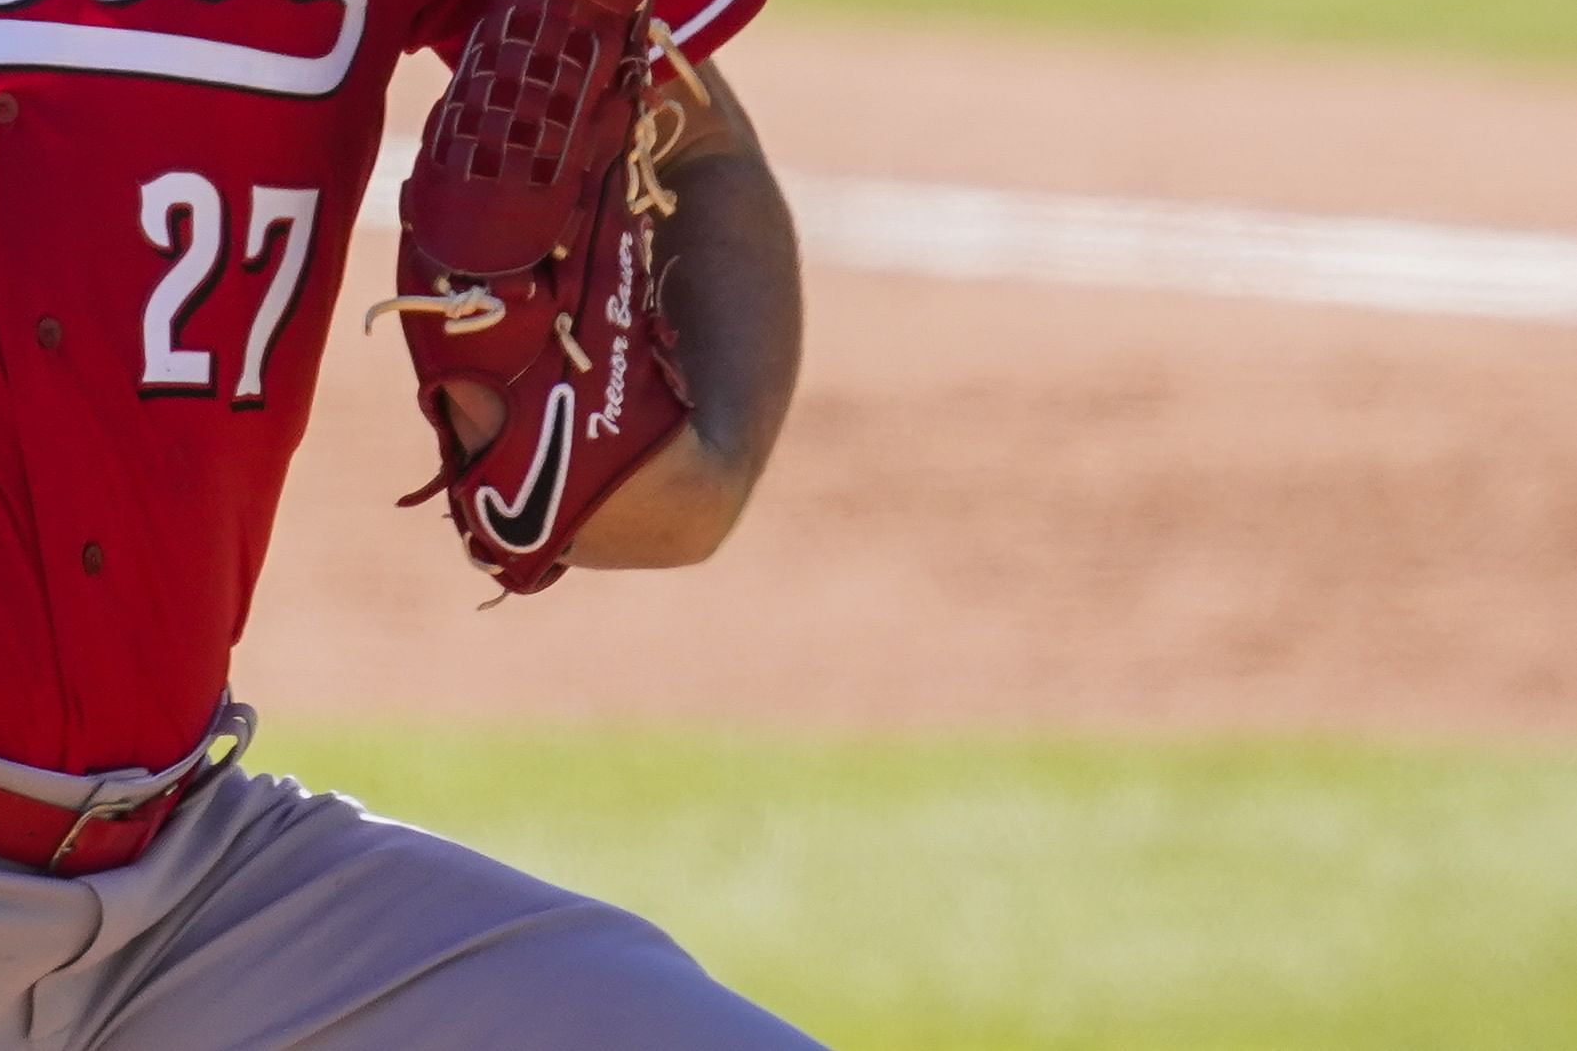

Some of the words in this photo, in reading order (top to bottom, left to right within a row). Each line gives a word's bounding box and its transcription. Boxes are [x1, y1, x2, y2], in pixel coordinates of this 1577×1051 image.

[138, 170, 319, 402] 27
[605, 231, 633, 329] Bauer
[586, 335, 629, 439] Trevor
